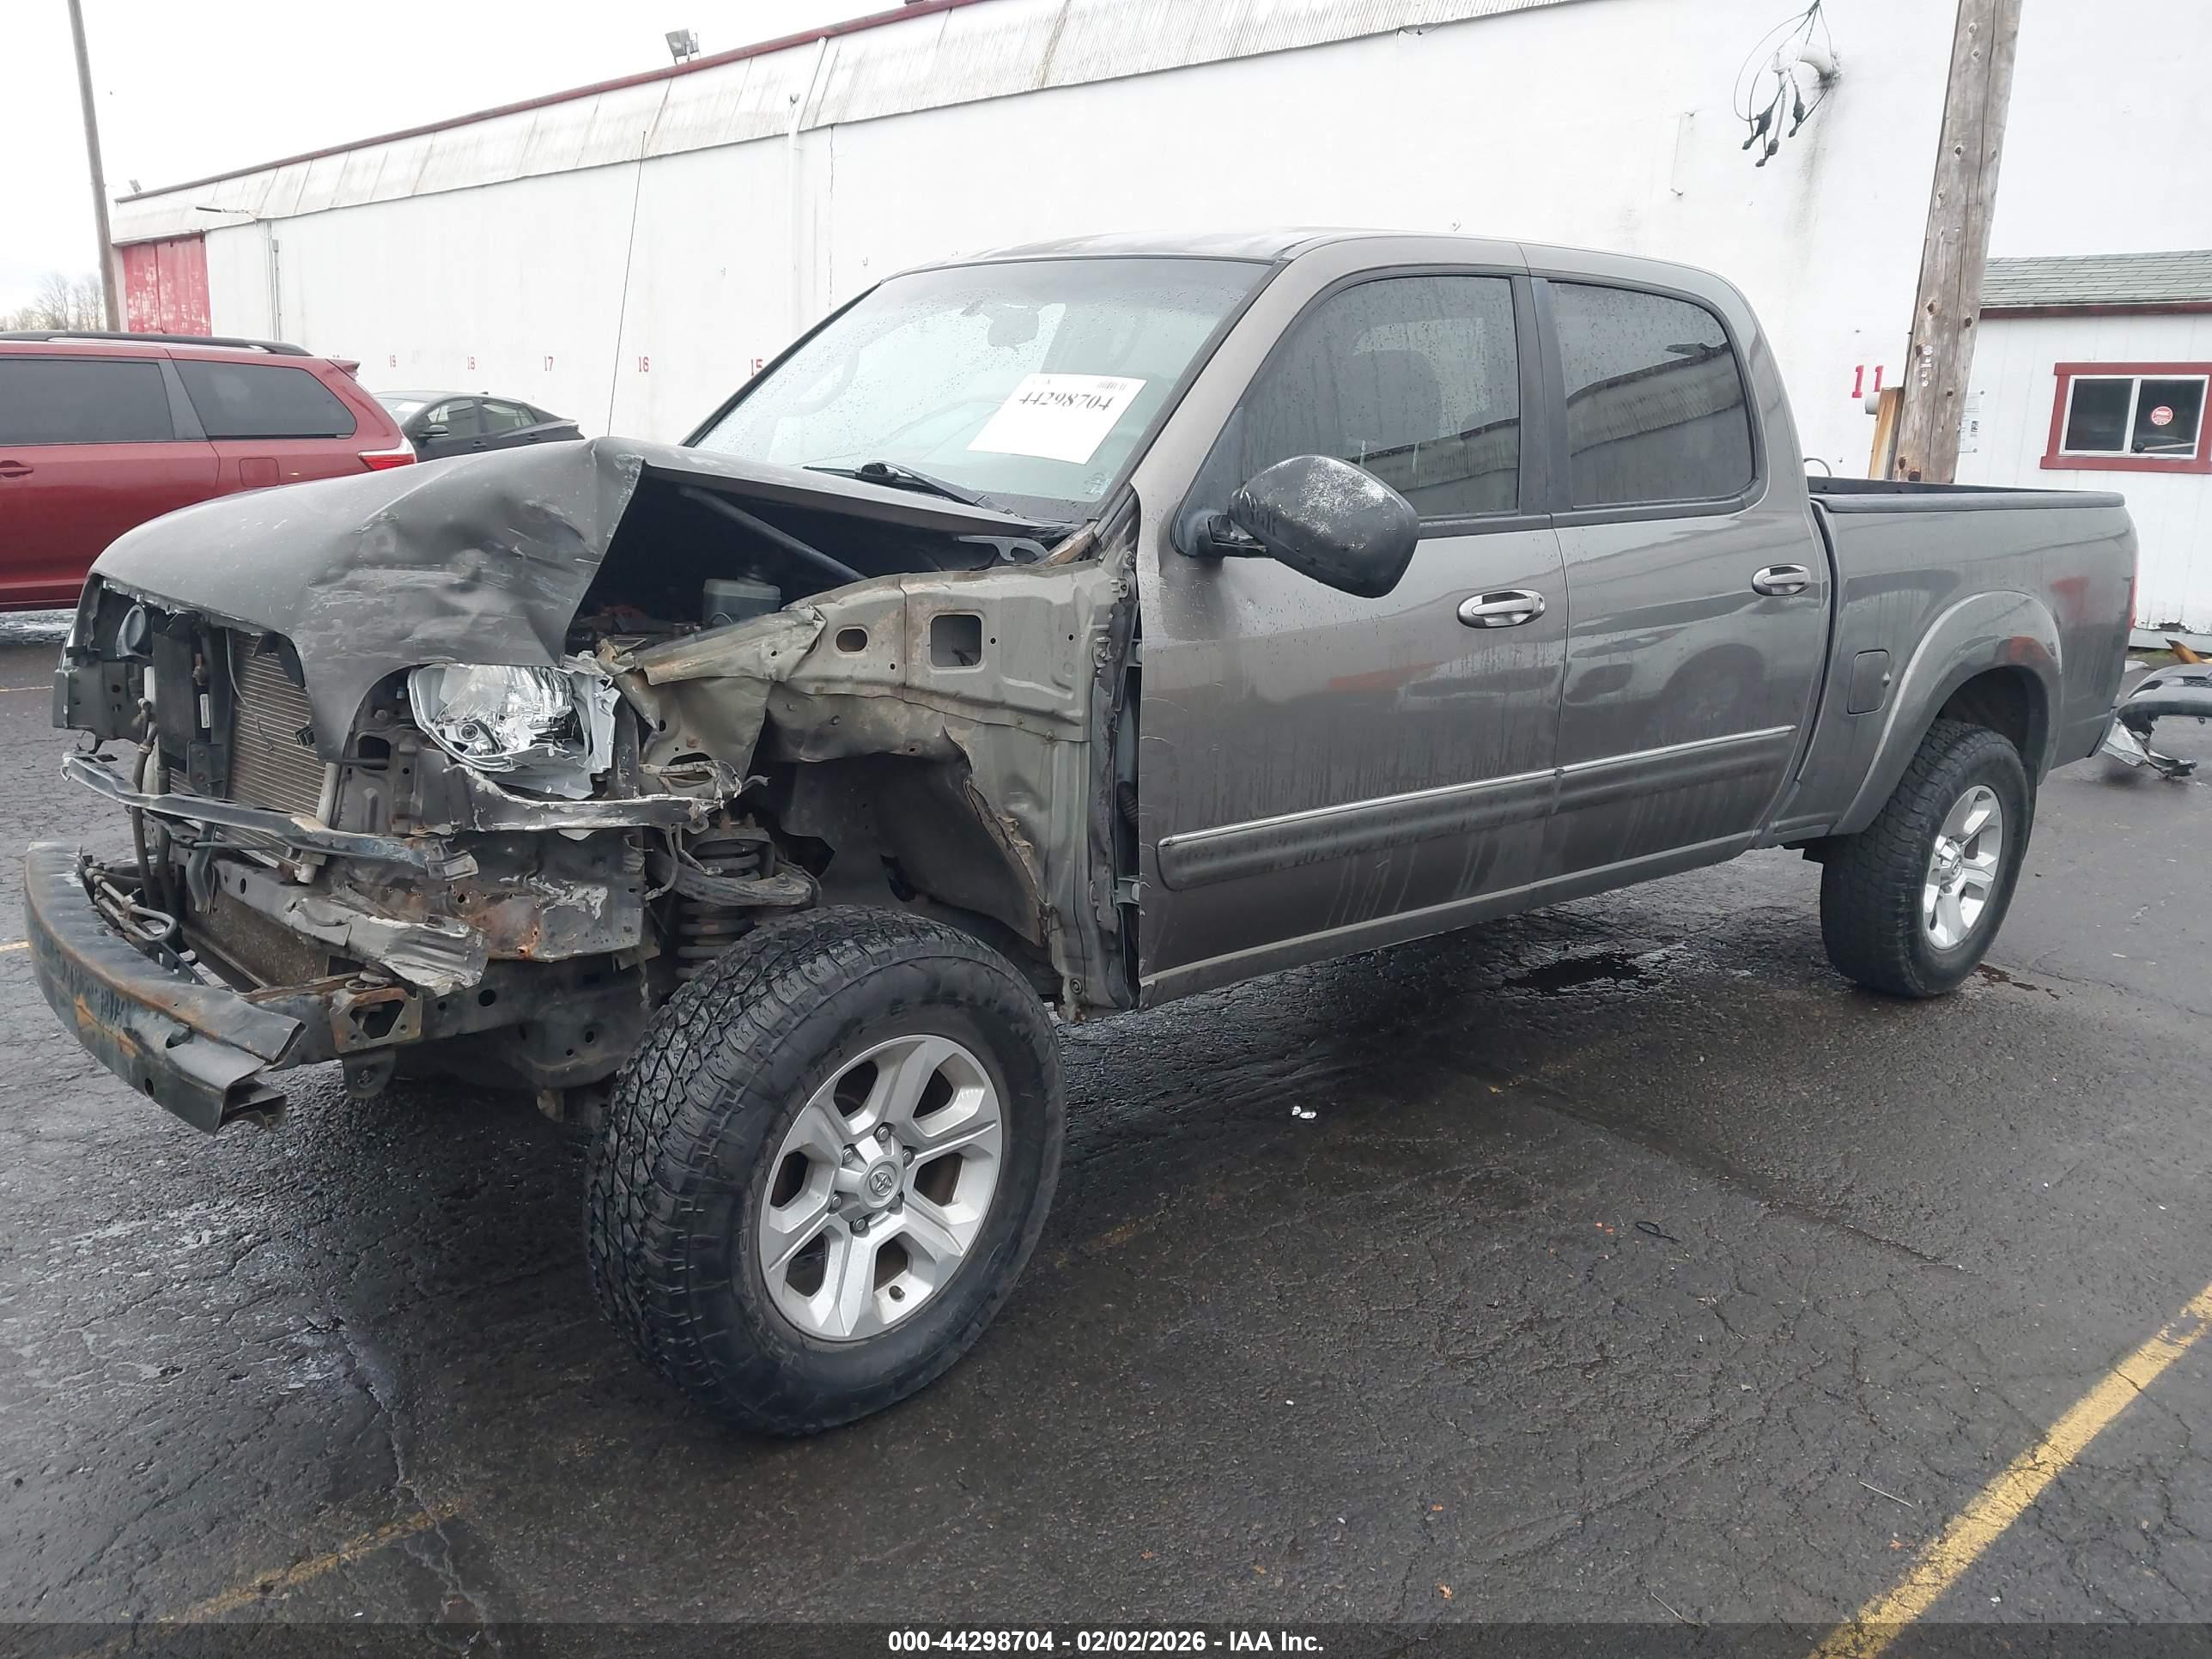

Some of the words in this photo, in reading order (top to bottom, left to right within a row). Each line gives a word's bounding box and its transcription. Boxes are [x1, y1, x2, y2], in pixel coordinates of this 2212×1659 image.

[544, 356, 554, 372] 17
[638, 356, 649, 373] 16
[1851, 364, 1884, 398] 11
[1019, 392, 1115, 410] 44298704
